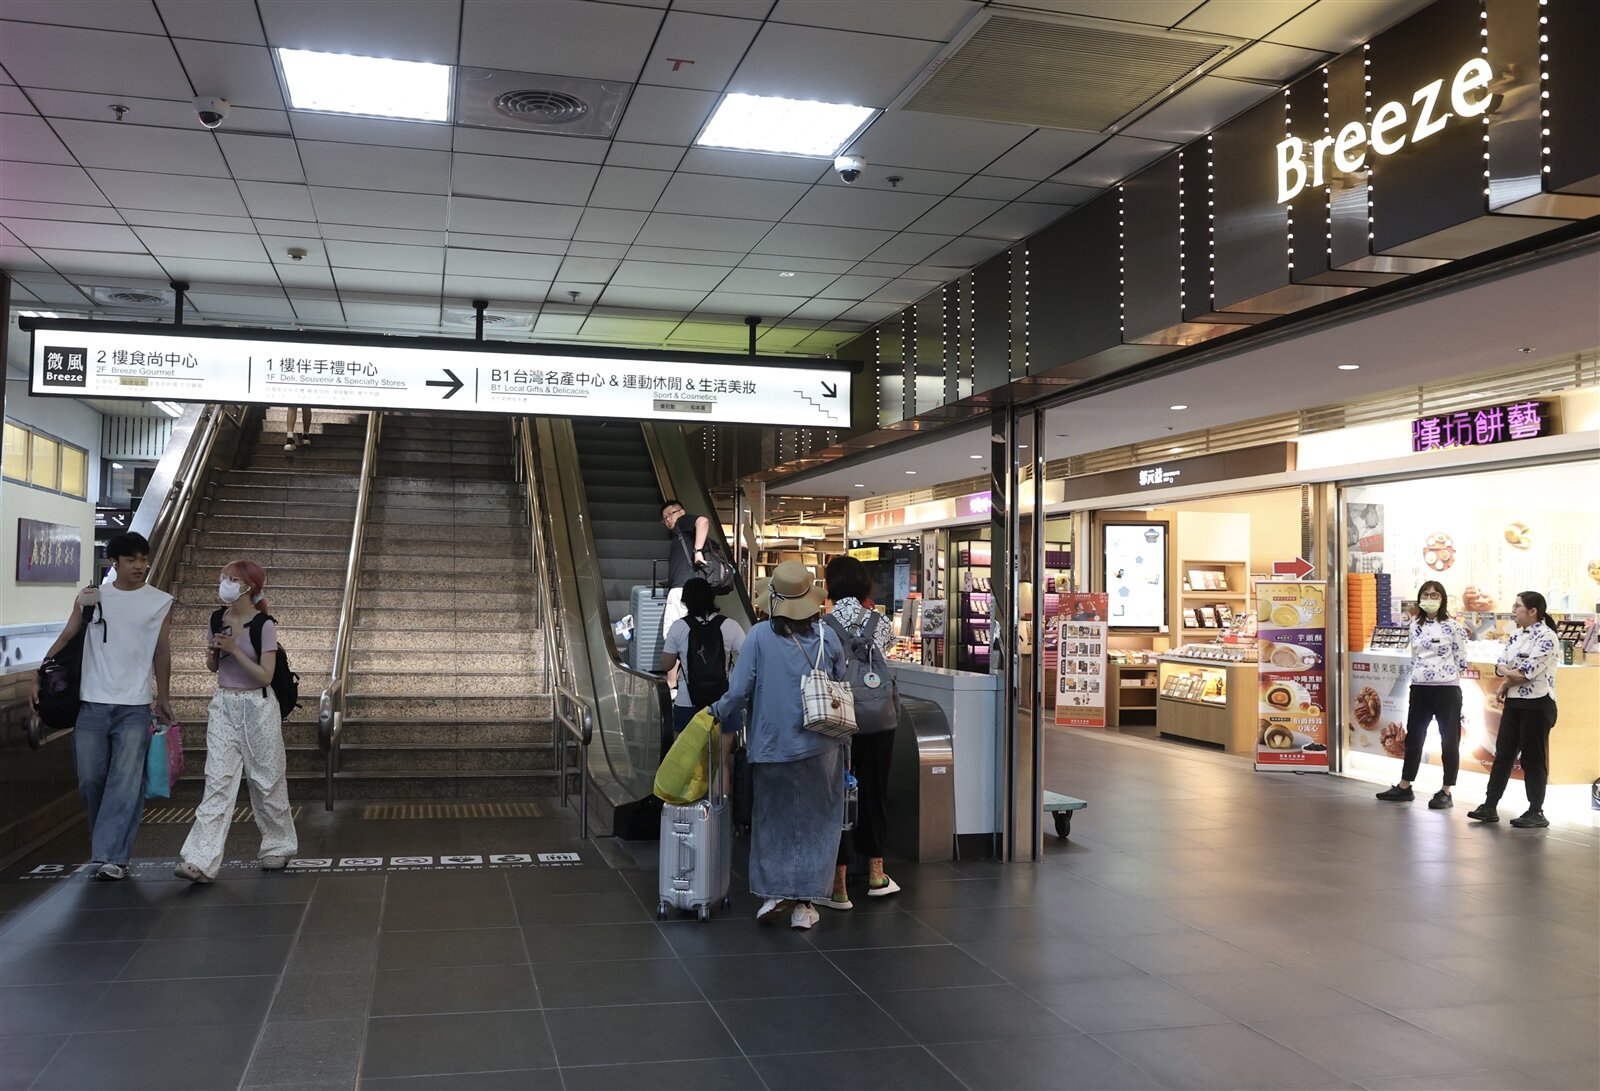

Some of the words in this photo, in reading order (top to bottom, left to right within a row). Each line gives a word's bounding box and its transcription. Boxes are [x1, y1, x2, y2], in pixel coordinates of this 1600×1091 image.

[1276, 57, 1494, 205] Breeze
[47, 352, 84, 372] 微風
[112, 349, 199, 369] 樓食尚中心
[279, 357, 379, 377] 樓伴手禮中心
[46, 372, 83, 382] Breeze
[96, 366, 107, 374] 2F
[112, 366, 138, 375] Breeze
[138, 367, 175, 377] Gourmet
[300, 375, 334, 384] Souvenir
[335, 376, 342, 384] &
[344, 377, 379, 387] Specialty
[381, 379, 406, 387] Stores
[504, 384, 525, 392] Local
[526, 385, 544, 393] Gifts
[552, 386, 590, 395] Delicacies
[609, 375, 619, 387] &
[686, 378, 696, 390] &
[698, 378, 757, 395] 生活美妝
[653, 391, 673, 400] Sport
[681, 392, 718, 401] Cosmetics
[1411, 401, 1542, 452] 漢坊餅藝
